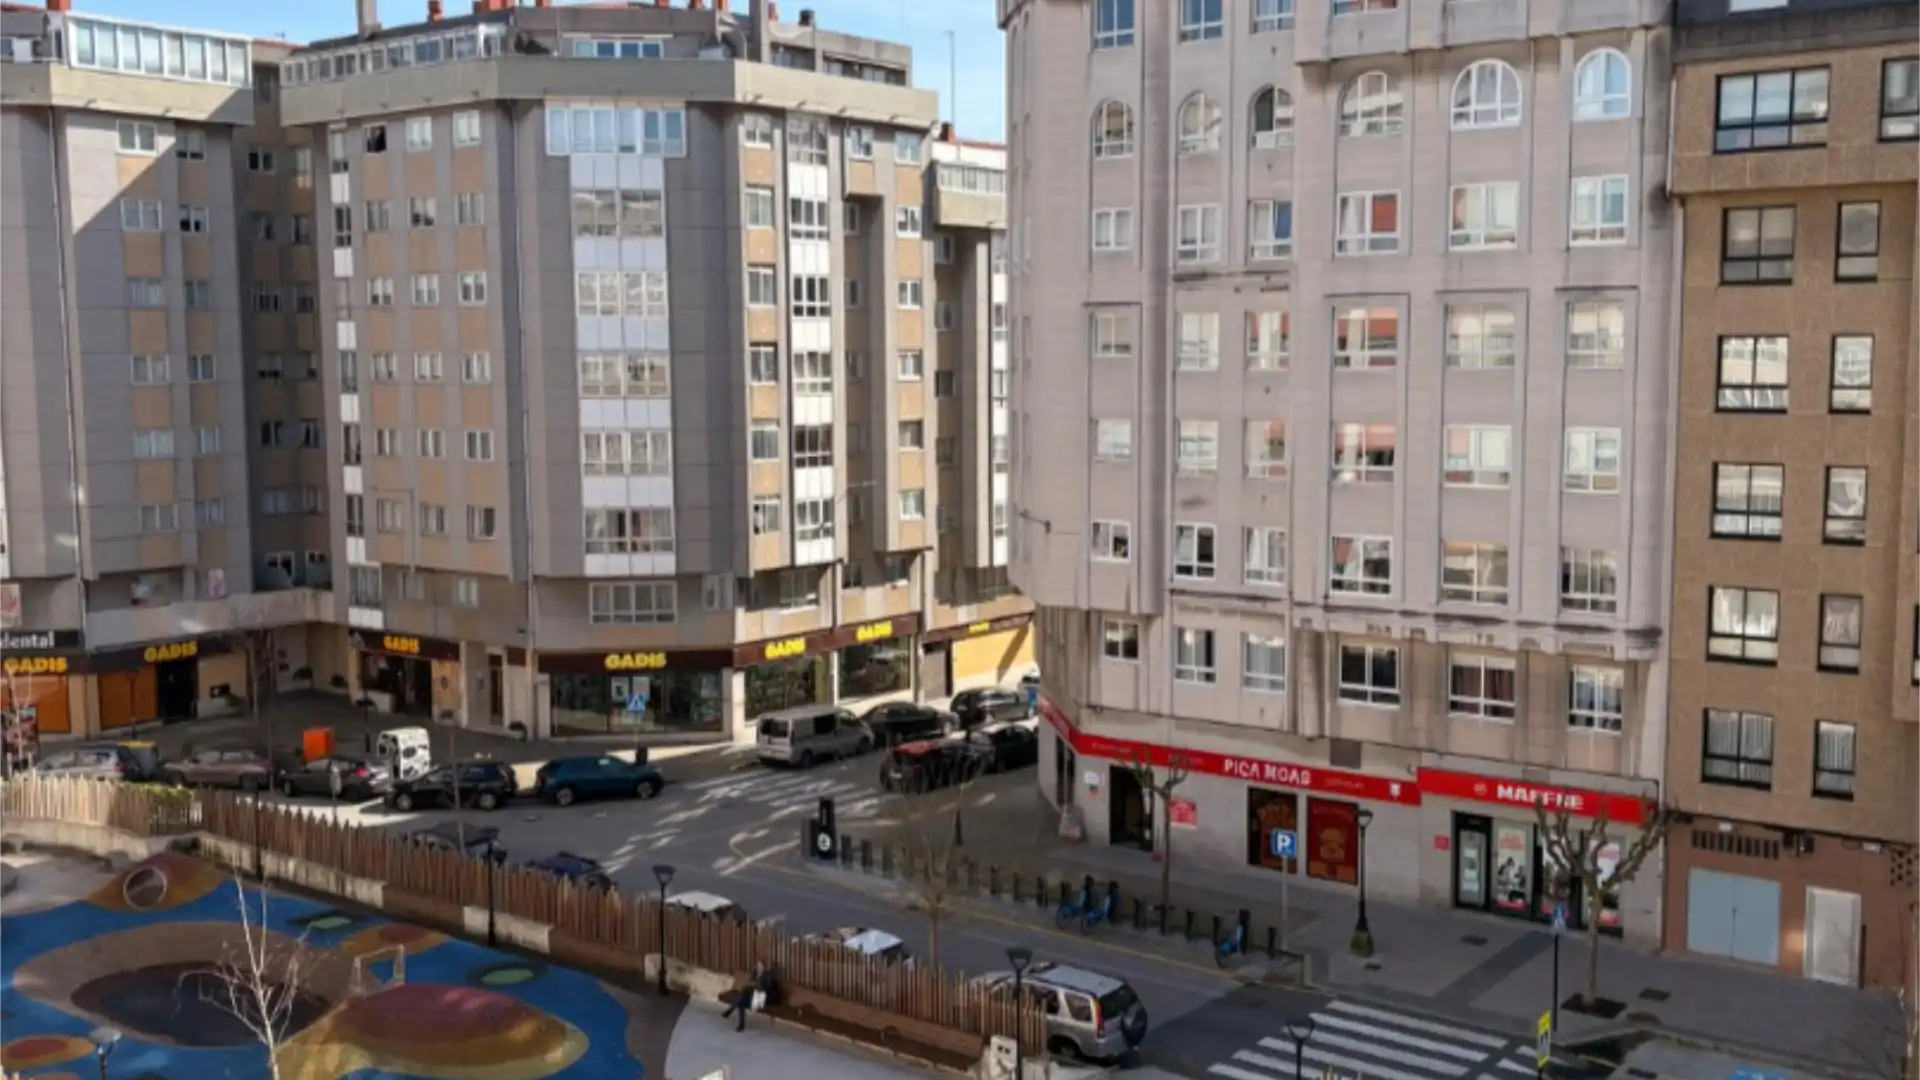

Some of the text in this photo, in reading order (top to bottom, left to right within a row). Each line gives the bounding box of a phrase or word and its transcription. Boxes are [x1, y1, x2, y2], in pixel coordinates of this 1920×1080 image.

[144, 641, 198, 663] GADIS
[604, 652, 667, 670] GADIS
[4, 656, 67, 673] GADIS
[1277, 831, 1291, 853] P
